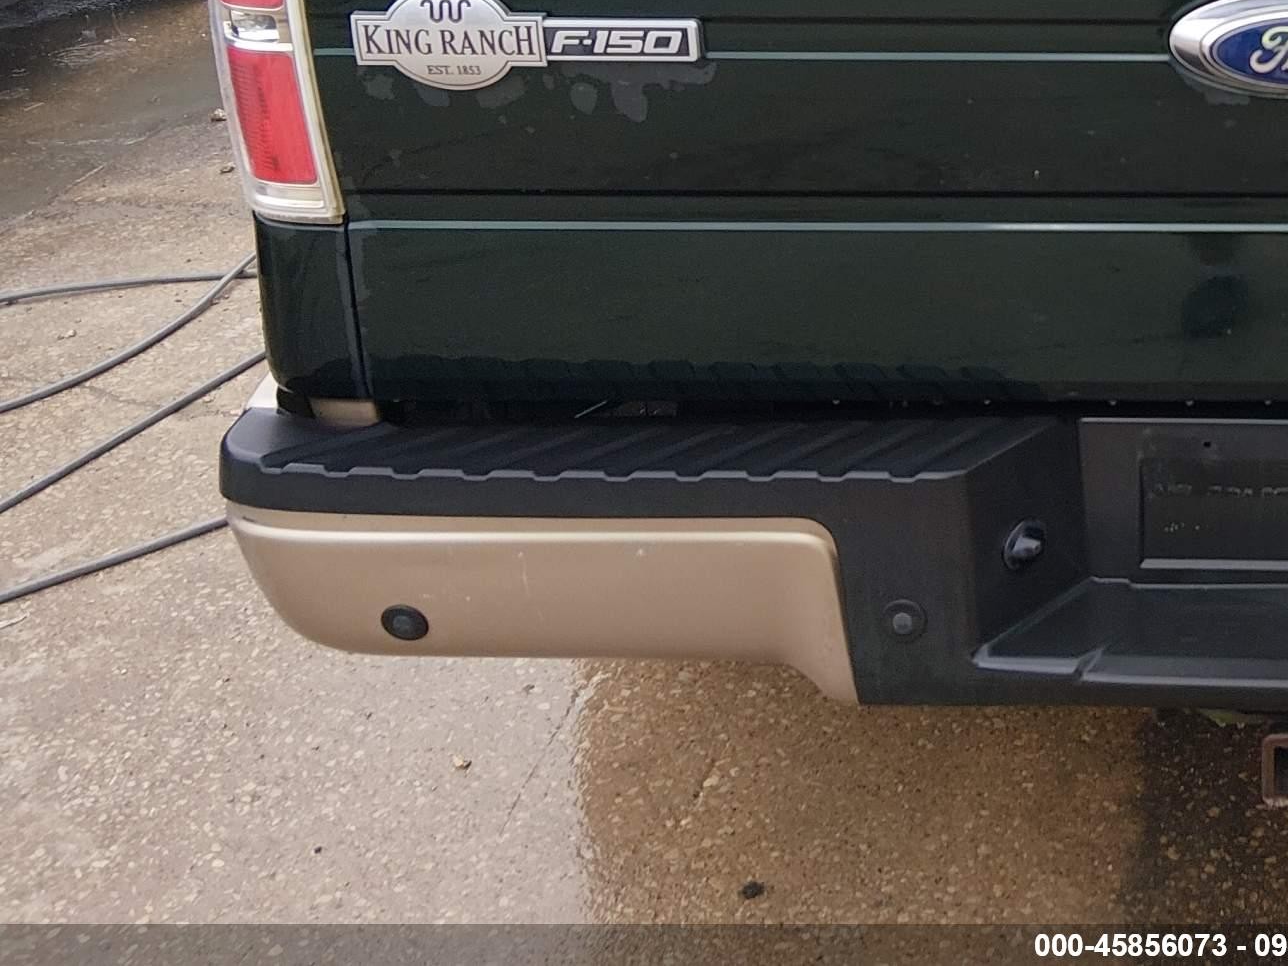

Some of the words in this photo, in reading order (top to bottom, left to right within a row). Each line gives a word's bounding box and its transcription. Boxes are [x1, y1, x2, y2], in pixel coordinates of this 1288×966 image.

[362, 24, 432, 55] KING
[440, 25, 537, 56] RANCH
[550, 30, 684, 54] F-150
[427, 65, 454, 76] EST.
[457, 65, 482, 76] 1853
